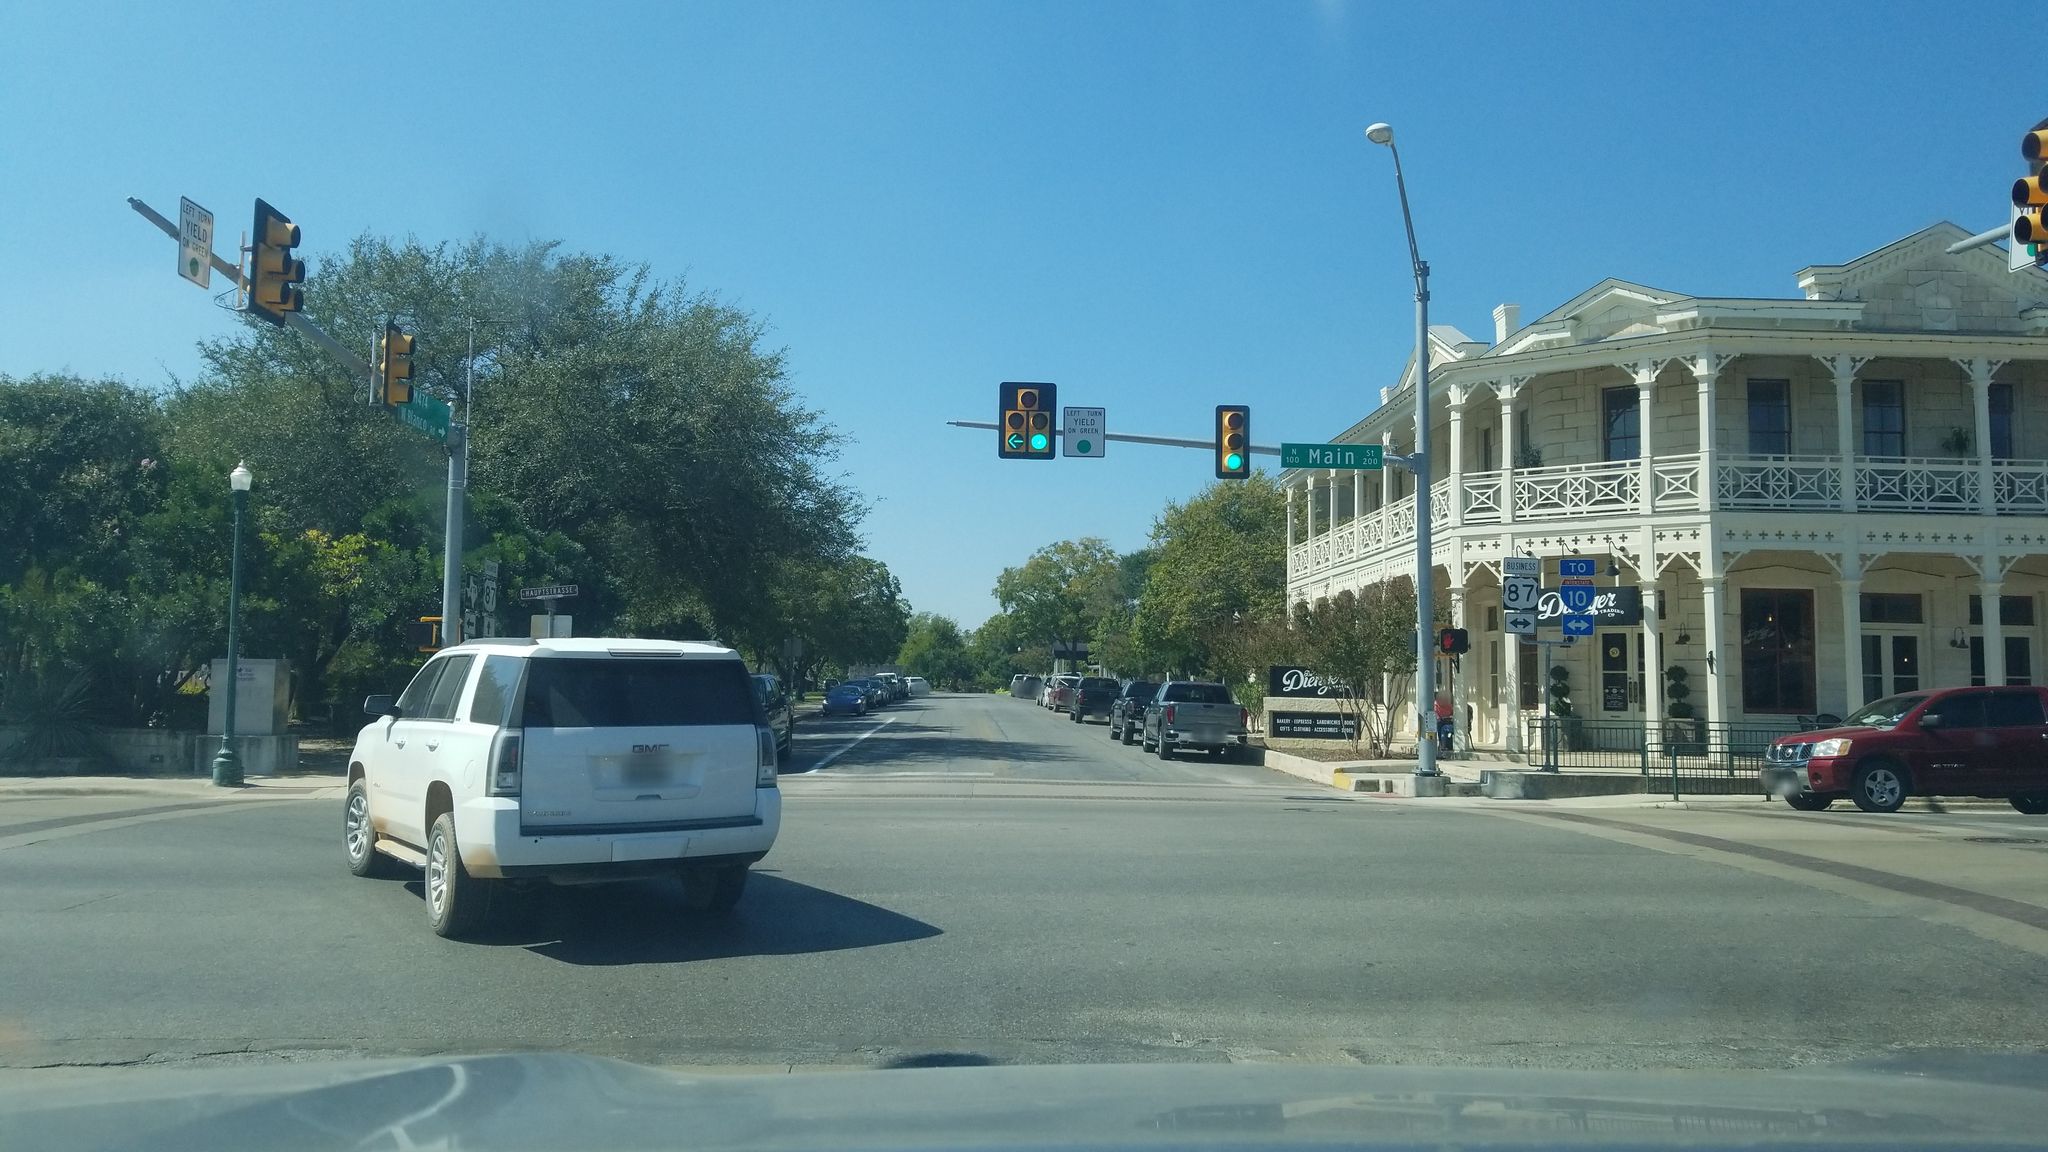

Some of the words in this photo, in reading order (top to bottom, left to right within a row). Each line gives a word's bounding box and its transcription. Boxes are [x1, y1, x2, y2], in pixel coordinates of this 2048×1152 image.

[183, 203, 194, 216] LEFT
[198, 211, 211, 224] TURN
[185, 219, 207, 242] YIELD
[183, 237, 190, 247] ON
[192, 243, 208, 257] GREEN
[1073, 418, 1095, 426] YIELD
[1286, 456, 1300, 464] 100
[1362, 457, 1378, 465] 200
[1308, 448, 1355, 465] Main
[1366, 449, 1375, 457] St
[1506, 561, 1536, 571] BUSINESS
[1569, 562, 1586, 573] TO
[485, 585, 496, 605] 87
[525, 586, 574, 598] HAUPTSTRASSE
[1507, 583, 1535, 602] 87
[1568, 590, 1587, 607] 10
[632, 744, 670, 753] GMC
